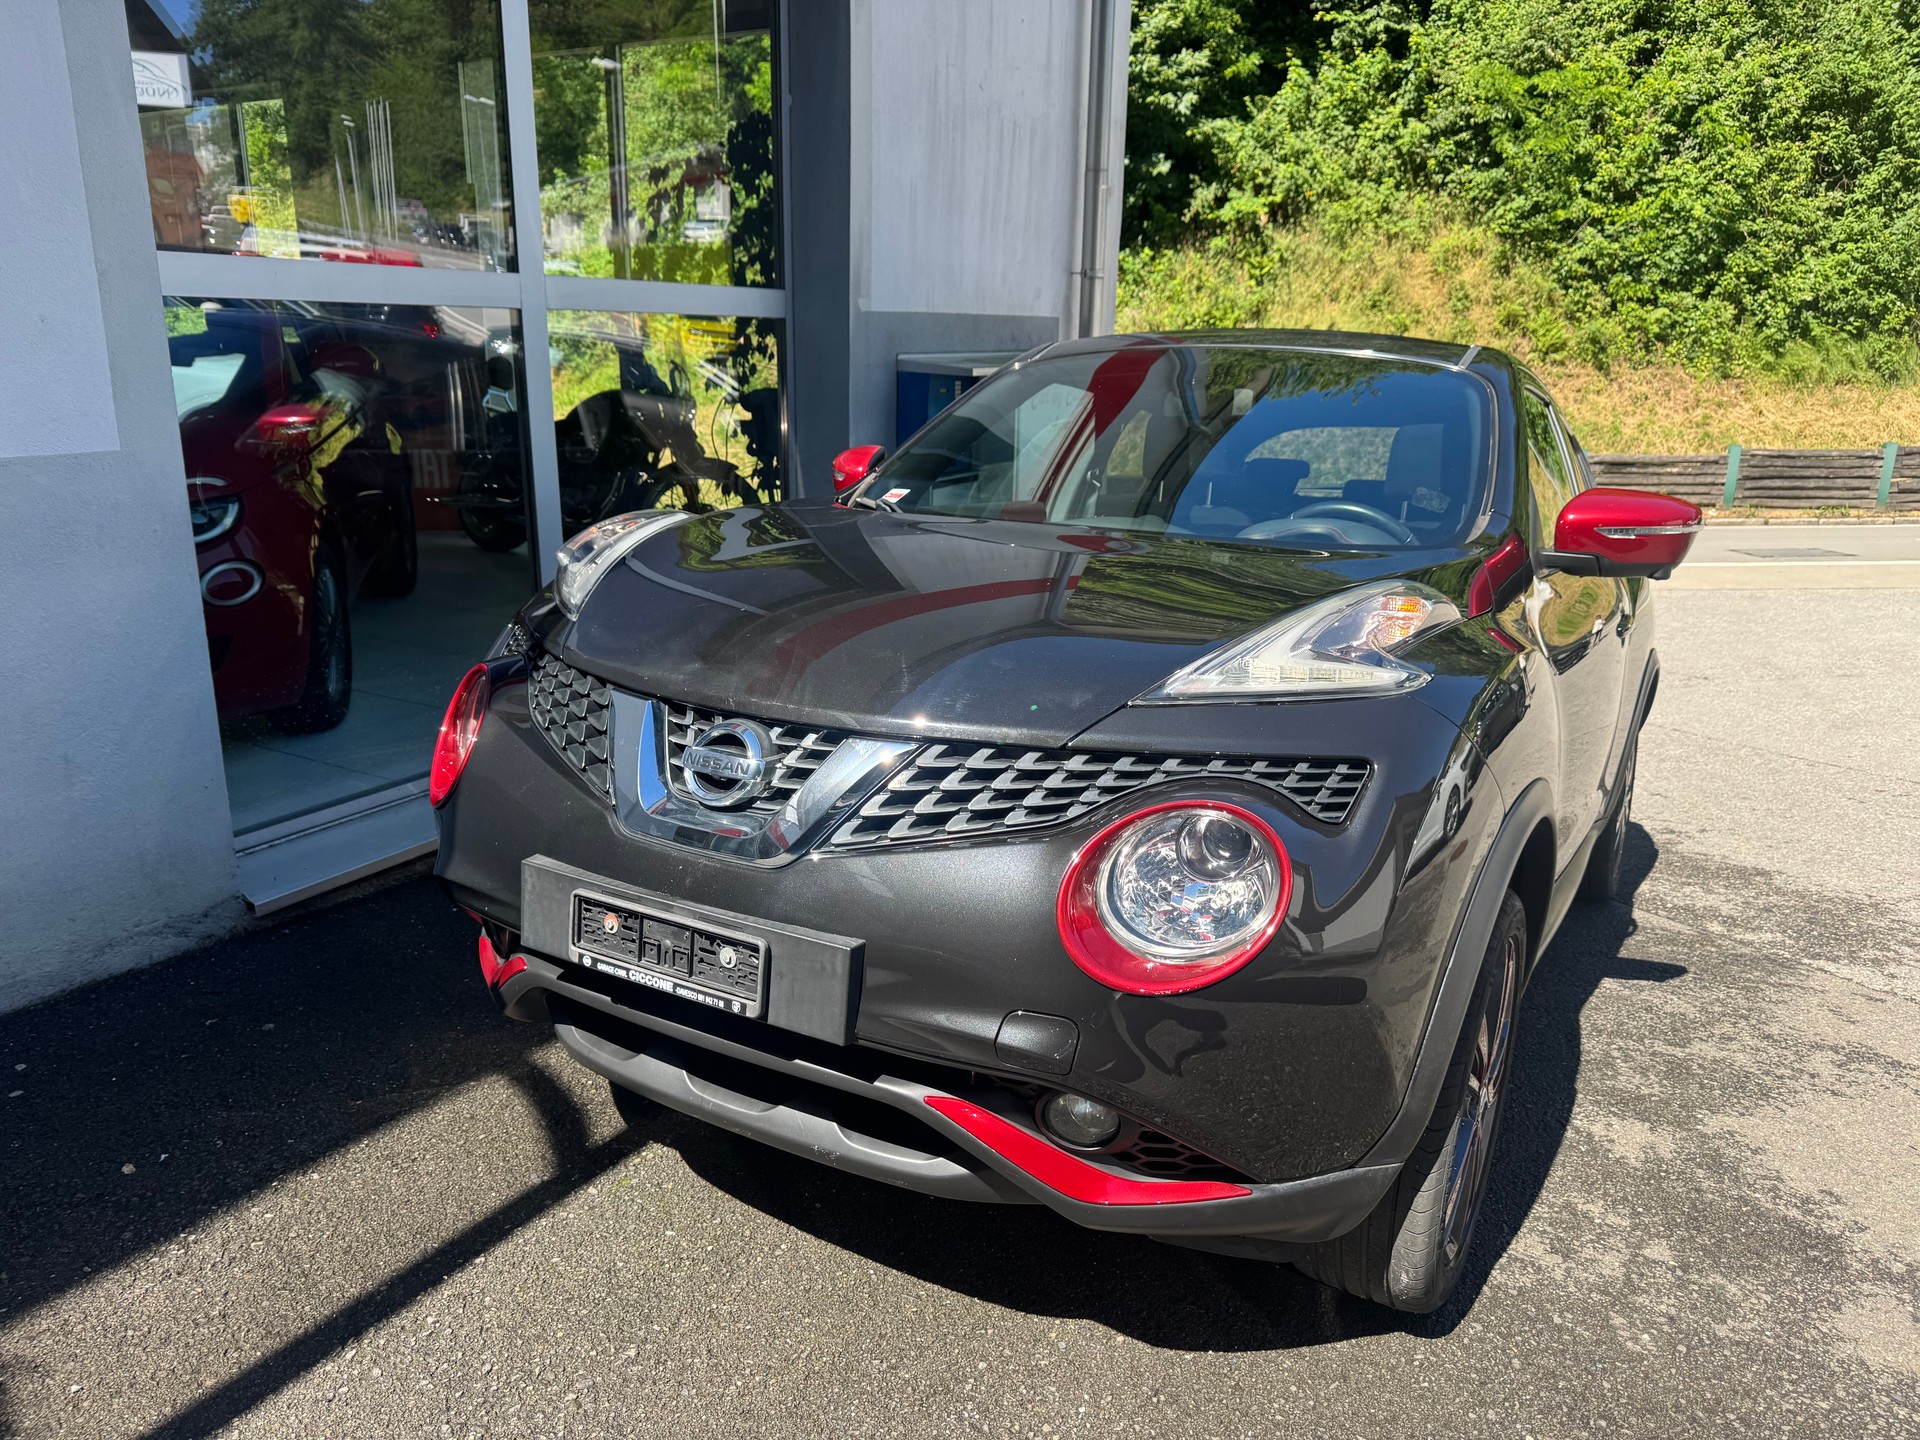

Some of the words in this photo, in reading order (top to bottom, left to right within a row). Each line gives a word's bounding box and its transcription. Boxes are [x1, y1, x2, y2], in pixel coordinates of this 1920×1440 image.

[407, 448, 451, 489] IAT
[685, 751, 751, 776] NISSAN
[628, 969, 673, 992] CICCONE
